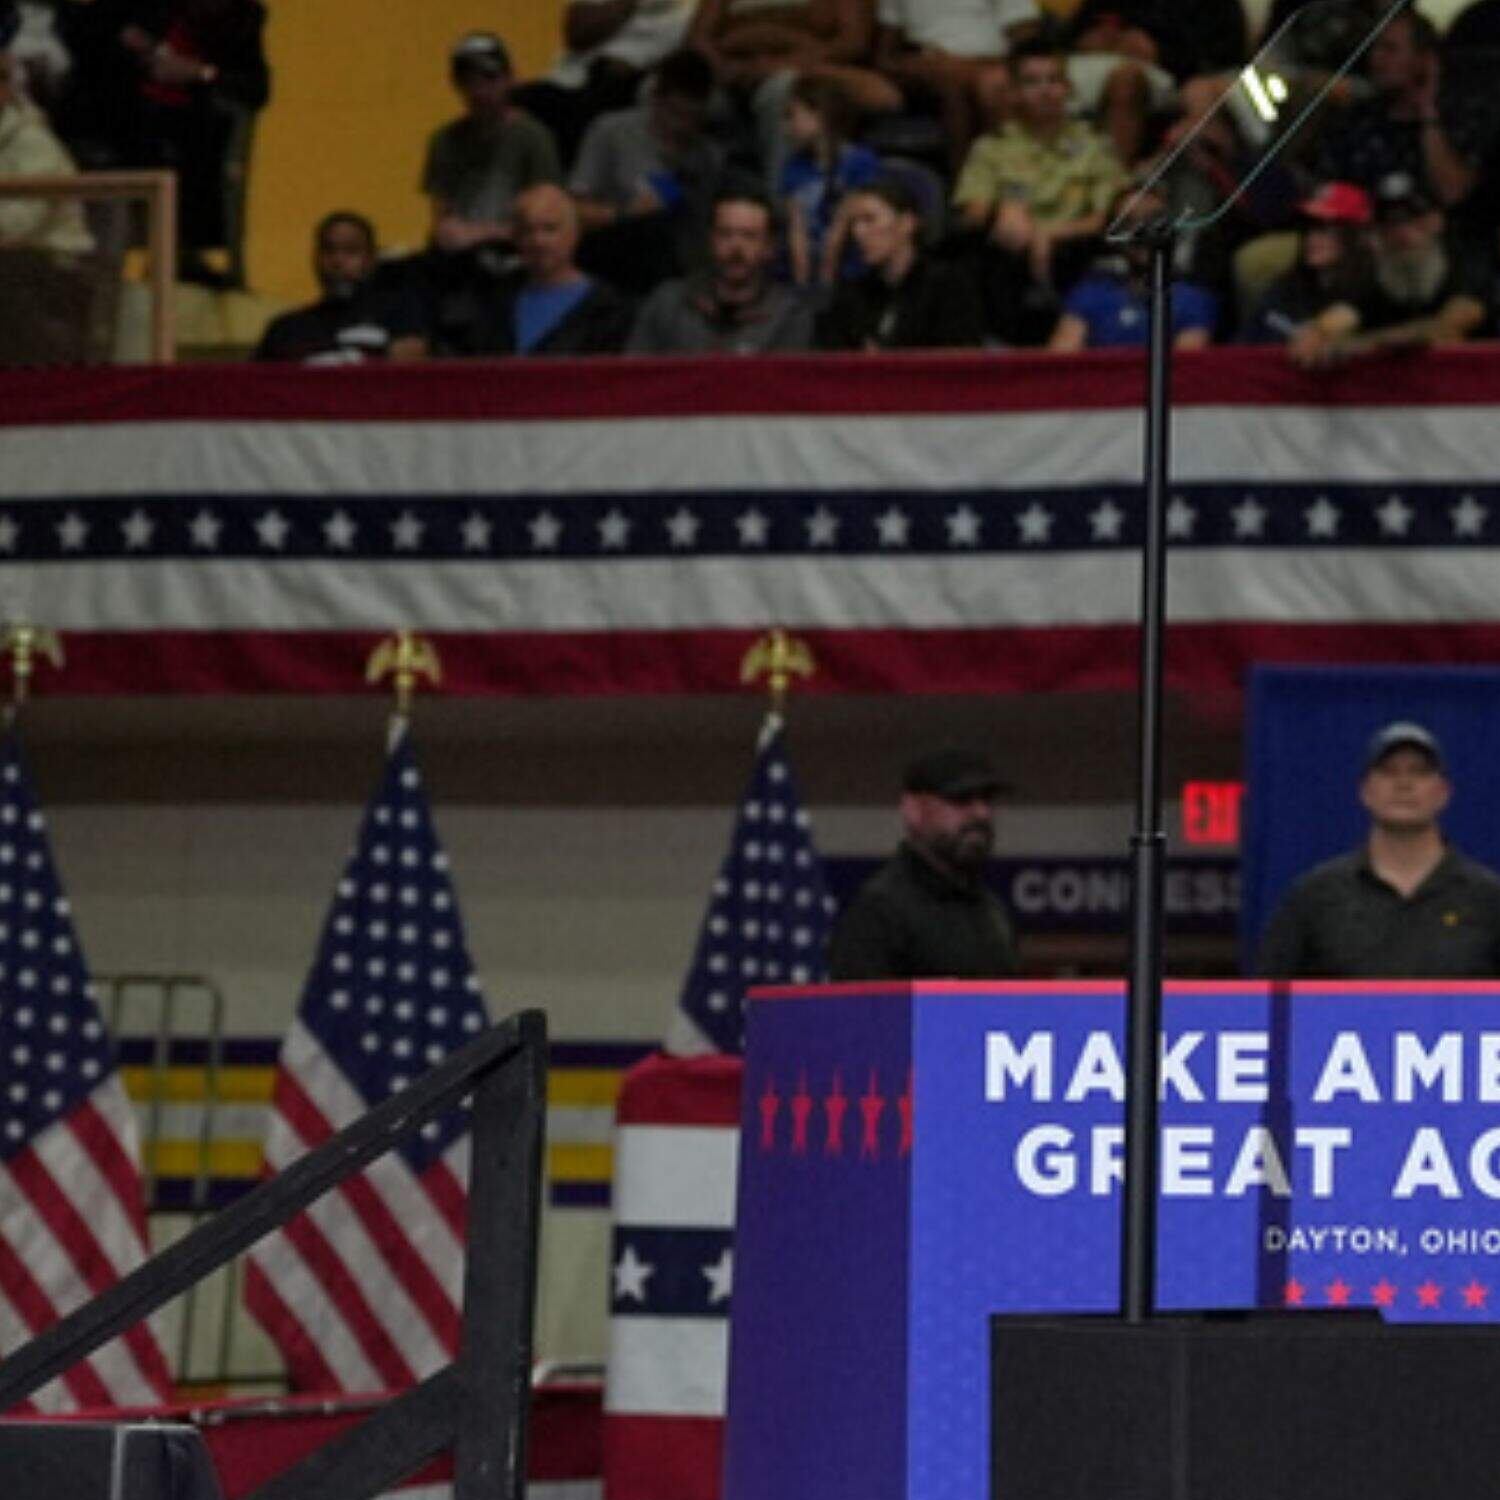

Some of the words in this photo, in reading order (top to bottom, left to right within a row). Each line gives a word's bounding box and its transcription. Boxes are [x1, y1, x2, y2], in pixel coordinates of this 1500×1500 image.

[986, 1032, 1270, 1101] MAKE
[1016, 1125, 1351, 1196] GREAT
[1265, 1226, 1408, 1256] DAYTON,
